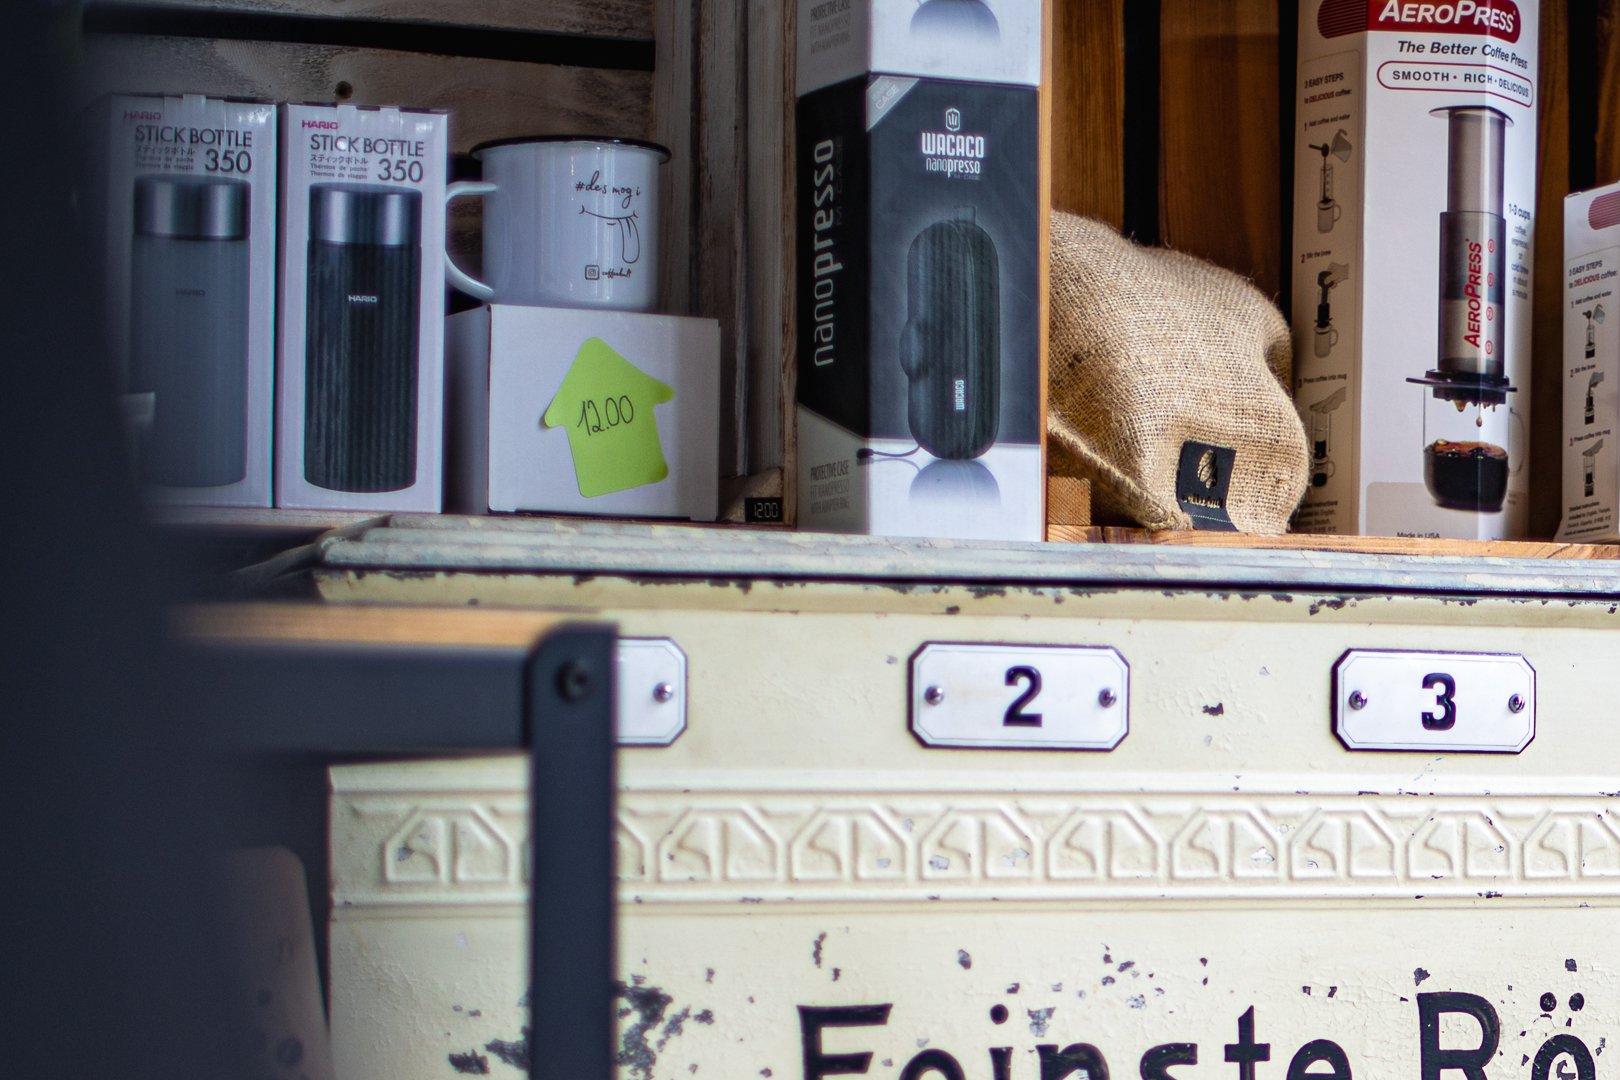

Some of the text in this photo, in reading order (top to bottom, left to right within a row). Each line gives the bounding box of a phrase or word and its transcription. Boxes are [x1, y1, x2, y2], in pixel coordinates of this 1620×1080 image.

[1398, 40, 1528, 70] The Better Coffee Press
[1392, 70, 1530, 98] SMOOTH RICH DELICIOUS
[123, 110, 162, 120] HARIO
[301, 120, 339, 130] HARIO
[135, 124, 253, 148] STICK BOTTLE
[310, 133, 425, 158] STICK BOTTLE
[921, 132, 985, 159] WACACO
[205, 148, 253, 174] 350
[310, 154, 368, 165] スティックボトル
[377, 158, 424, 183] 350
[925, 156, 981, 179] nanopresso
[813, 138, 844, 368] nanopresso
[1586, 260, 1603, 272] STEPS
[348, 294, 378, 304] HARIO
[576, 394, 634, 437] 12.00
[1002, 665, 1044, 728] 2
[1420, 672, 1458, 732] 3
